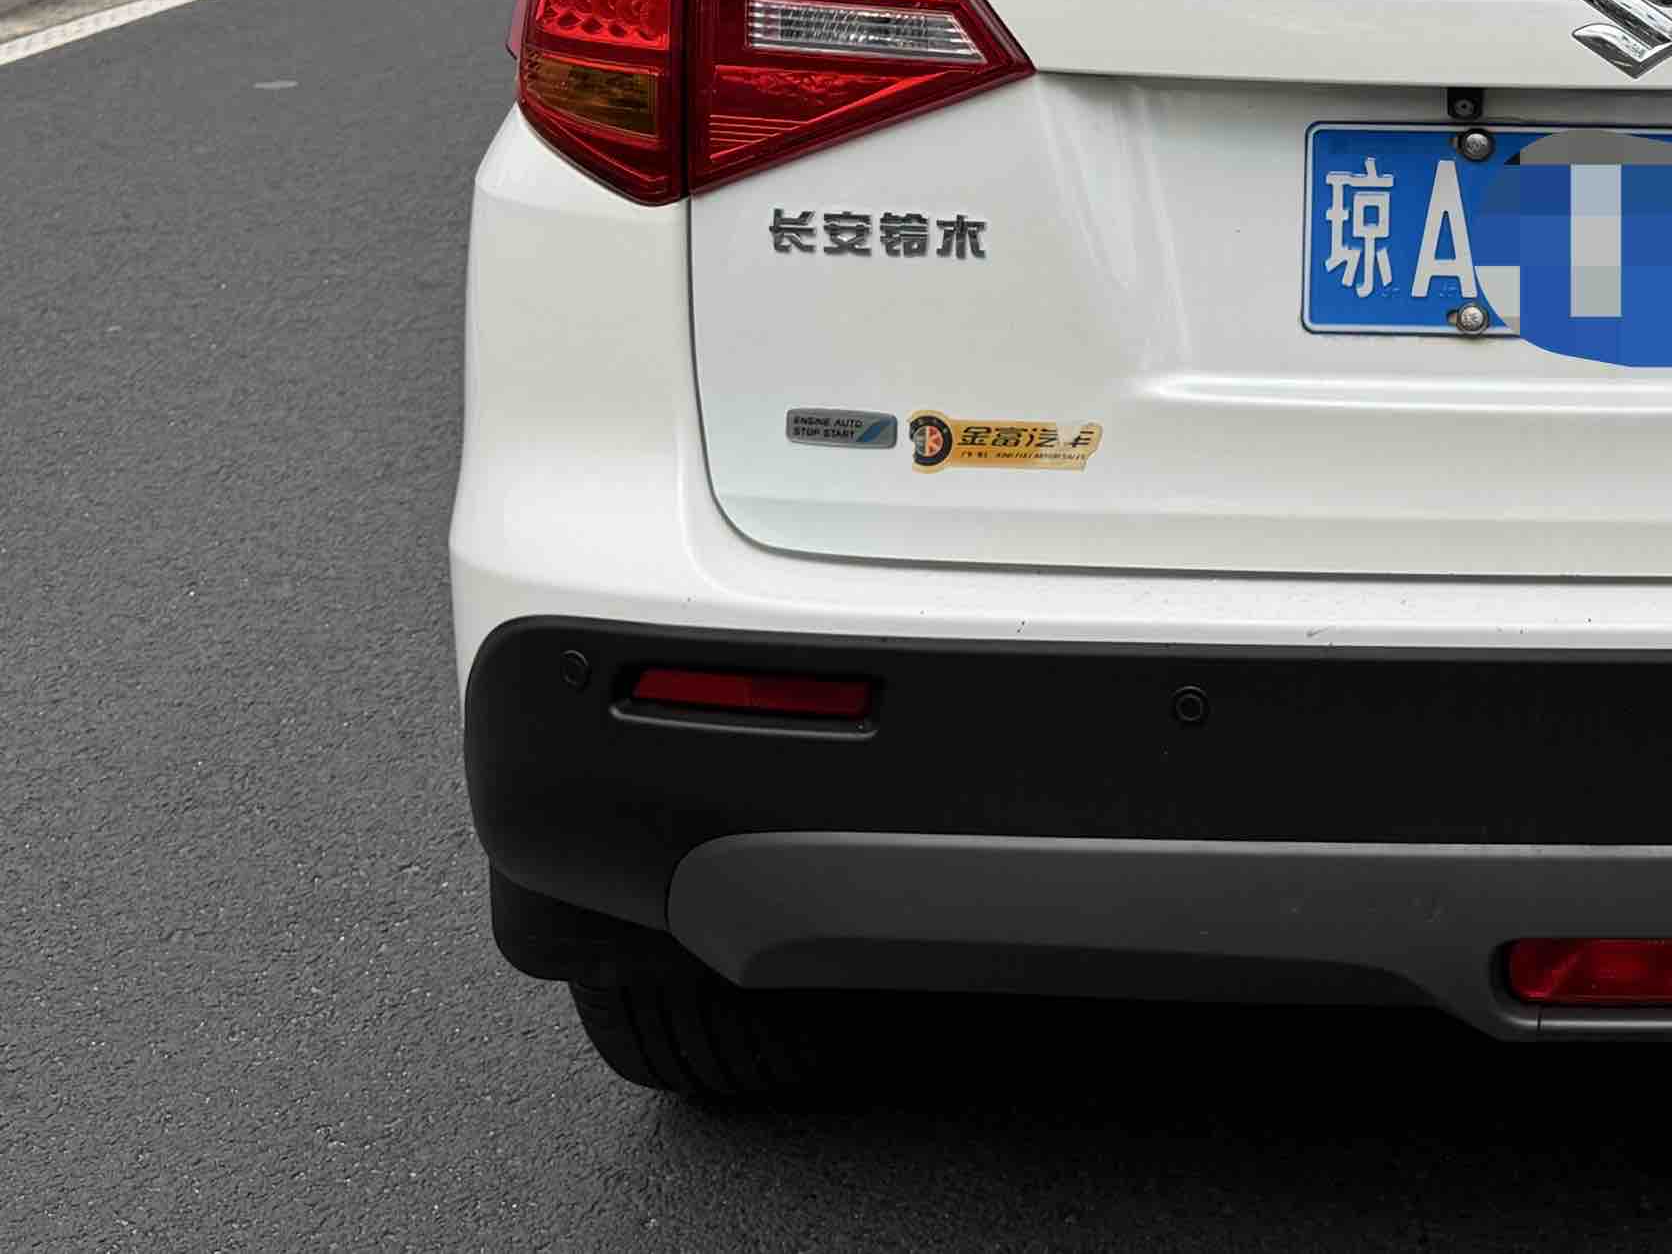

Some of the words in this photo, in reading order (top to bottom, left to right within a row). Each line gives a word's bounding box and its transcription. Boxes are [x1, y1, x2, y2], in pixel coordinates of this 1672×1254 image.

[770, 208, 987, 259] 长安铃木
[793, 415, 831, 427] ENGINE
[833, 417, 864, 429] AUTO
[793, 426, 820, 438] STOP
[823, 428, 855, 439] START
